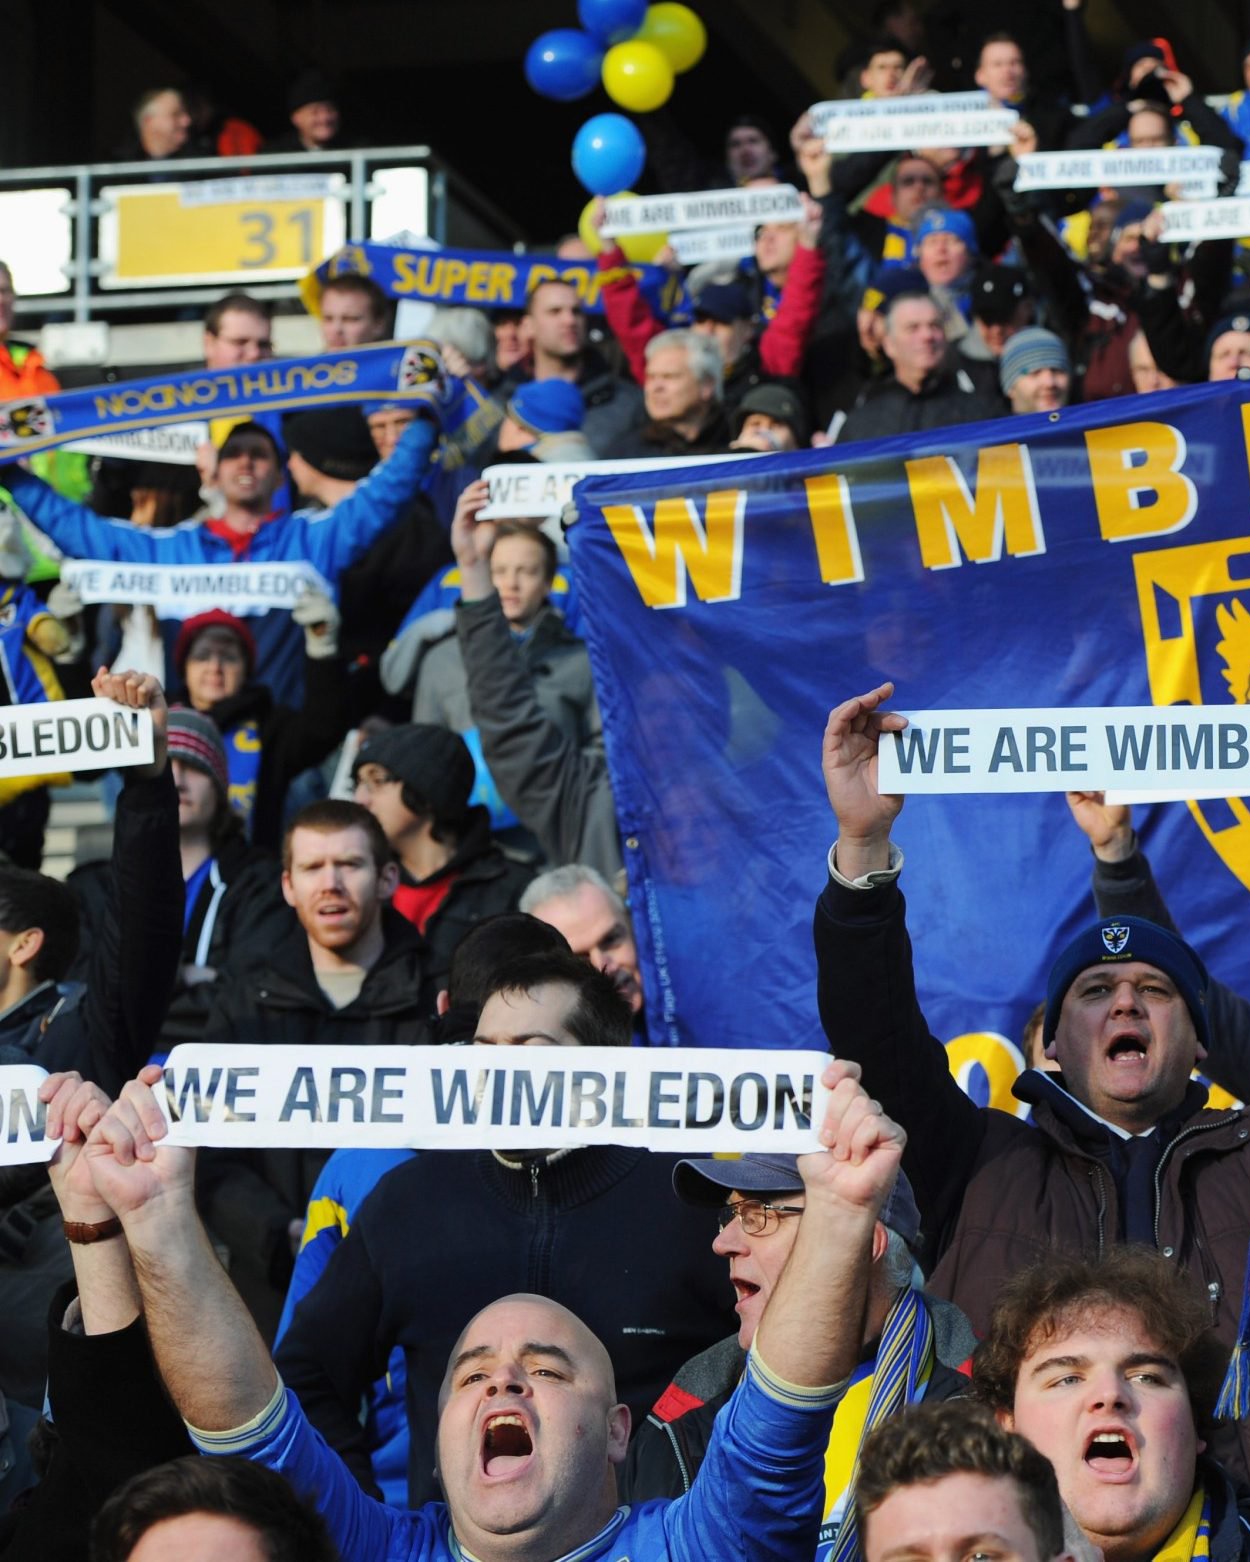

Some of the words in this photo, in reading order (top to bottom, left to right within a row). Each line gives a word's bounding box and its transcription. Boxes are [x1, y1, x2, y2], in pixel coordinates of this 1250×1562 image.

[1102, 152, 1221, 176] WIMBLEDON
[1204, 208, 1240, 227] ARE
[237, 208, 315, 269] 31
[392, 253, 517, 303] SUPER
[94, 379, 240, 420] LONDON
[241, 361, 359, 400] SOUTH
[488, 475, 530, 504] WE
[110, 572, 156, 595] ARE
[895, 726, 971, 775] WE
[988, 724, 1088, 774] ARE
[162, 1066, 261, 1124] WE
[279, 1066, 408, 1124] ARE
[430, 1067, 815, 1132] WIMBLEDON
